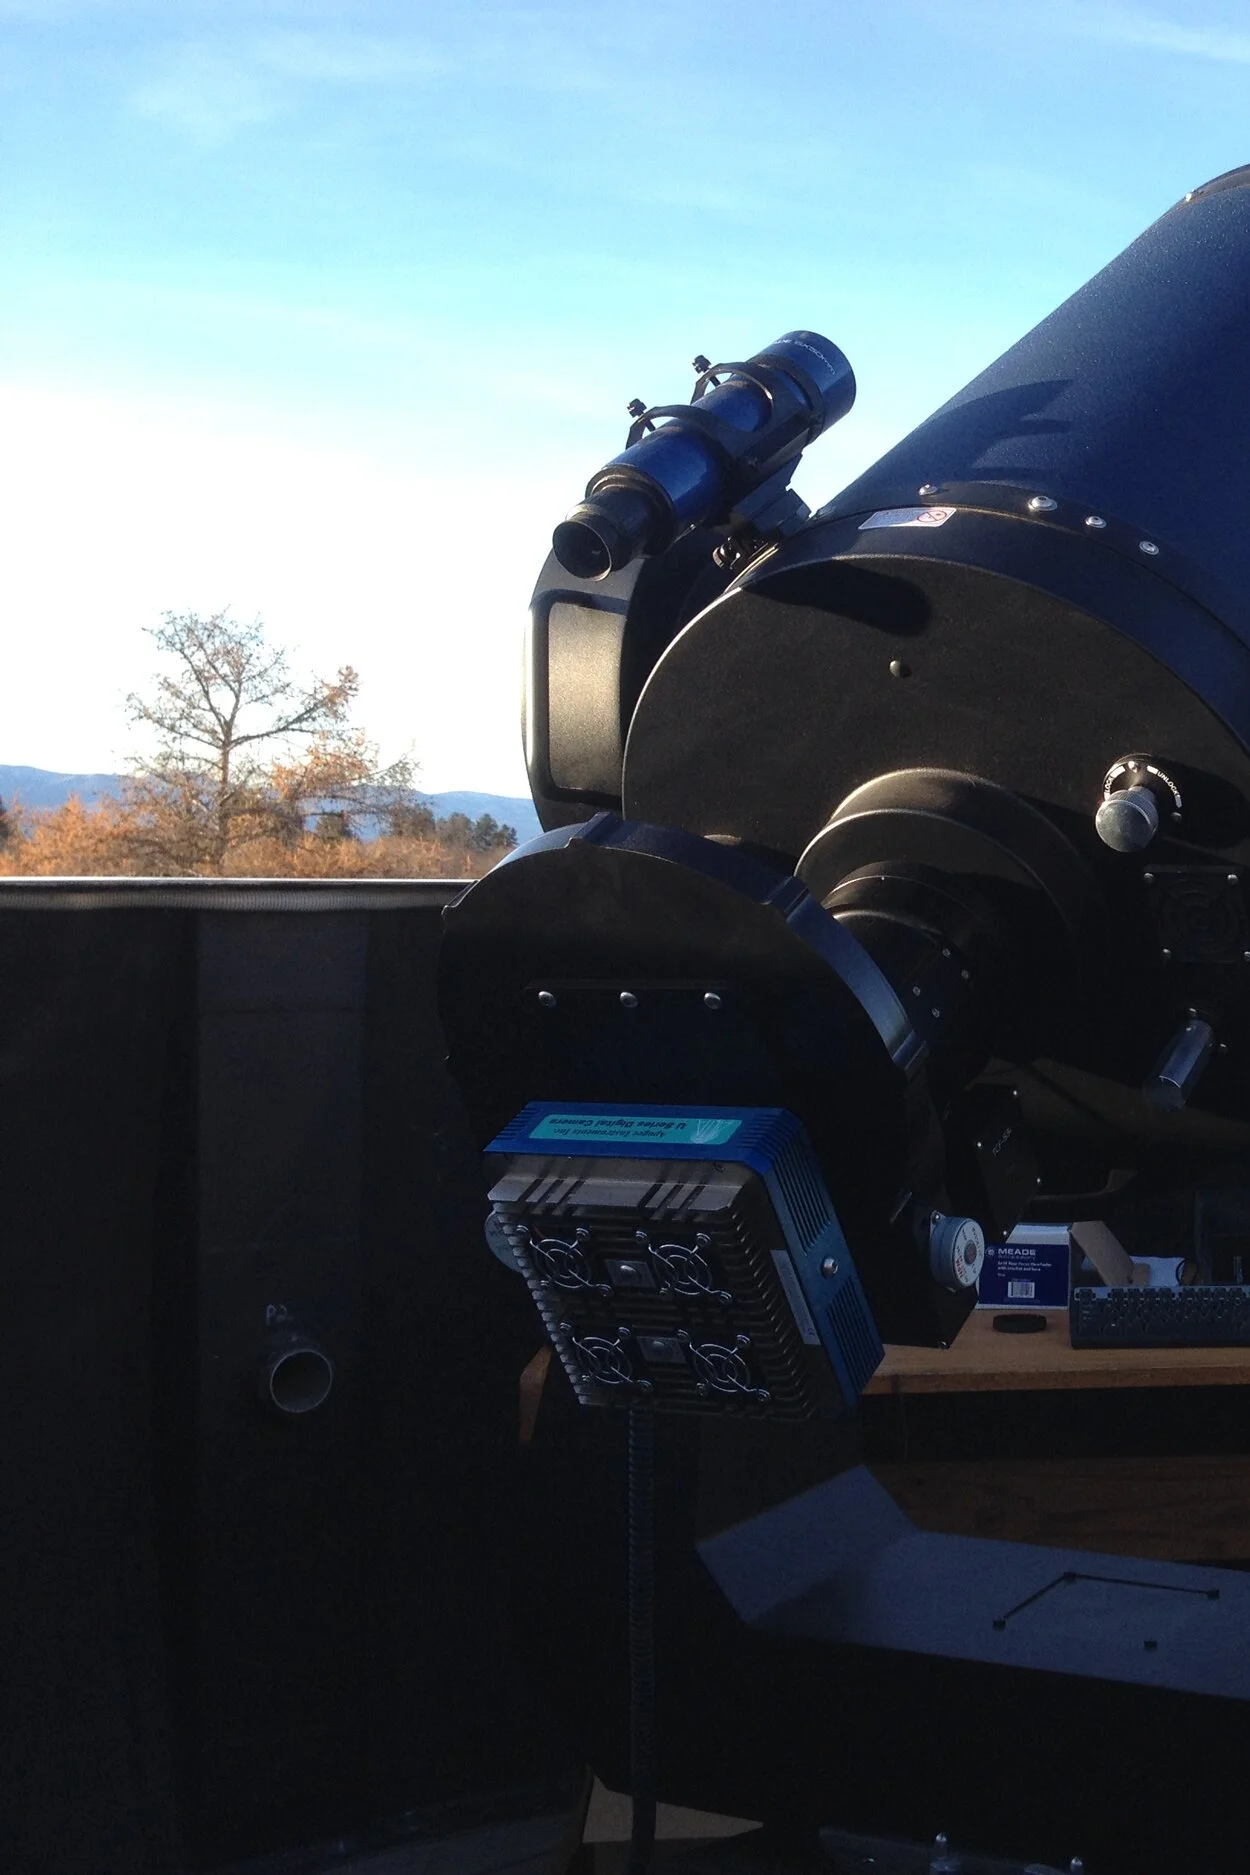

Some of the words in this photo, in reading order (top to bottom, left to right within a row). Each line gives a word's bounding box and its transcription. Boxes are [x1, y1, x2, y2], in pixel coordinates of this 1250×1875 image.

[1104, 776, 1114, 792] LOCK
[1157, 771, 1180, 796] UNLOCK
[549, 1119, 594, 1127] Camera
[595, 1119, 634, 1128] Digital
[636, 1121, 674, 1129] Series
[675, 1121, 687, 1130] U
[572, 1128, 631, 1137] Instruments
[997, 1248, 1036, 1256] MEADE
